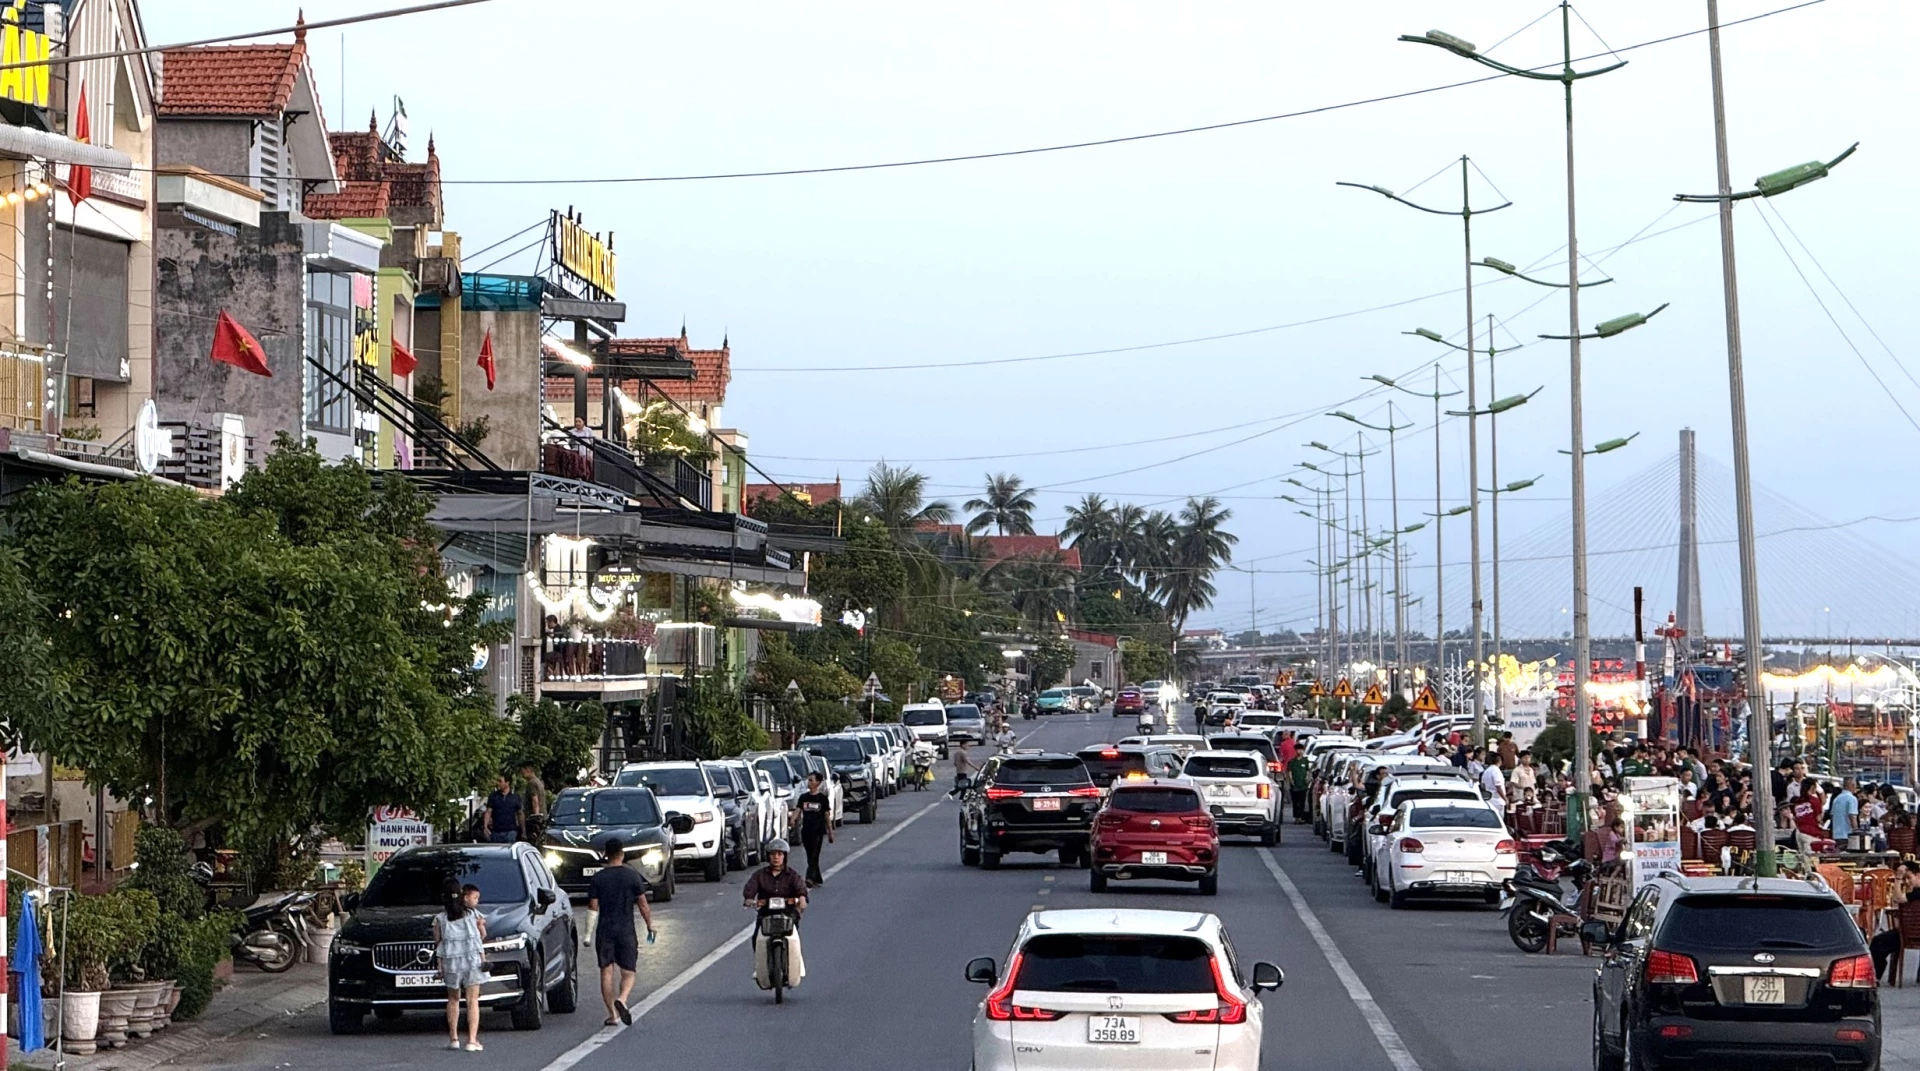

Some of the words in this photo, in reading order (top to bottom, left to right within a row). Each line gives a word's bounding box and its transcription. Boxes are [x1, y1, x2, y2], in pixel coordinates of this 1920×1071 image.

[1509, 720, 1528, 728] ANH
[1530, 719, 1542, 728] VŨ
[381, 824, 403, 836] HẠNH
[380, 835, 410, 847] MUỐI
[1752, 977, 1776, 989] 73H
[1750, 990, 1779, 1003] 1277
[1104, 1017, 1126, 1029] 73A
[1094, 1029, 1135, 1041] 358.89
